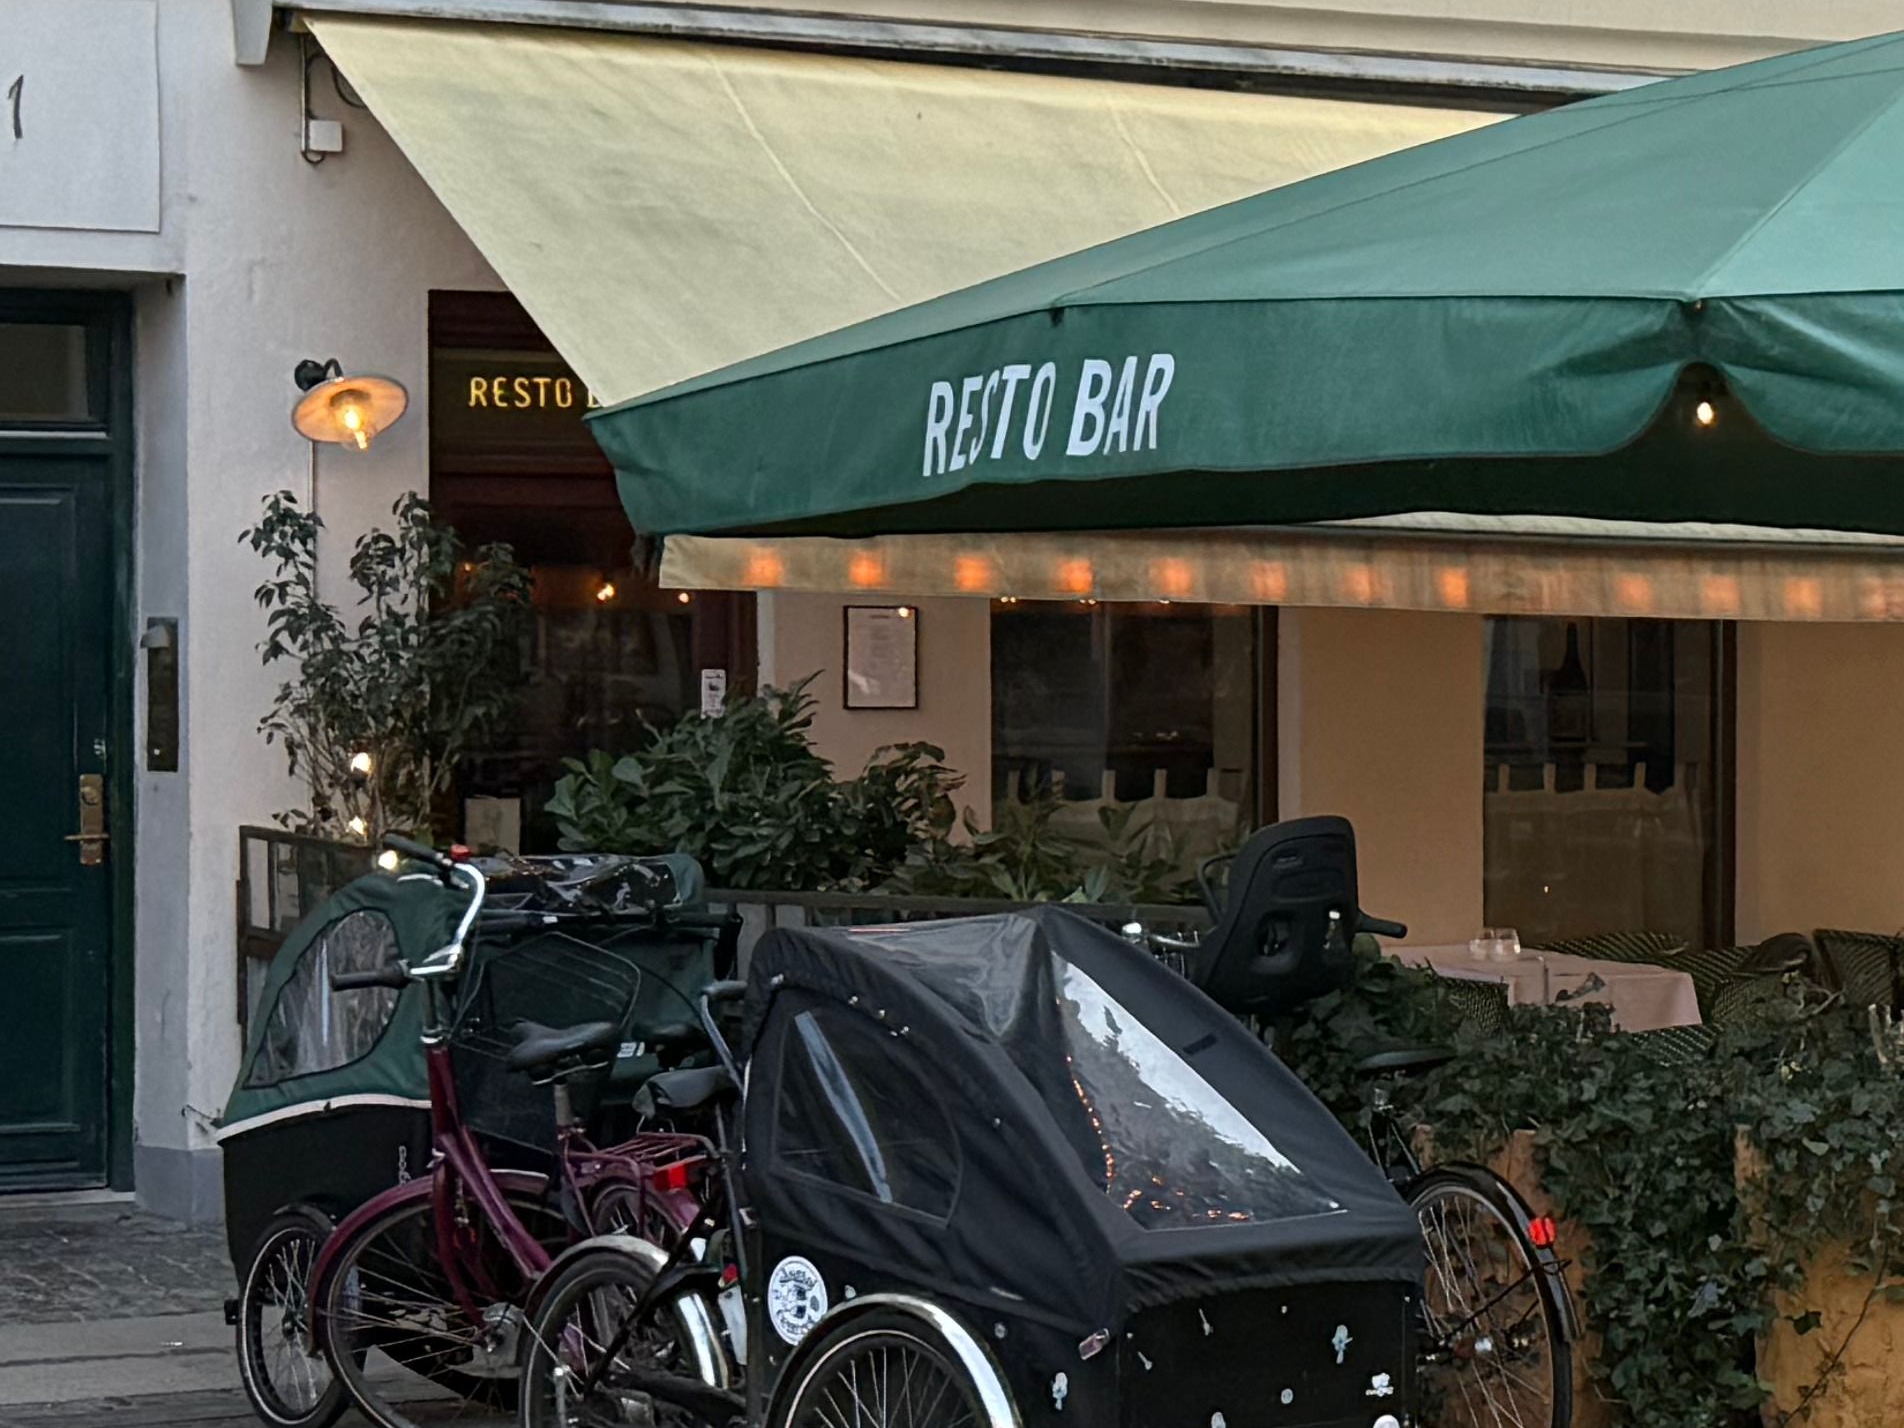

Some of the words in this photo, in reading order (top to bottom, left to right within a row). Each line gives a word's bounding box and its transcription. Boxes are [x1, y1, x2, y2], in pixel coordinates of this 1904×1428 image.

[468, 376, 573, 409] RESTO
[922, 362, 1057, 477] RESTO
[1066, 353, 1176, 456] BAR
